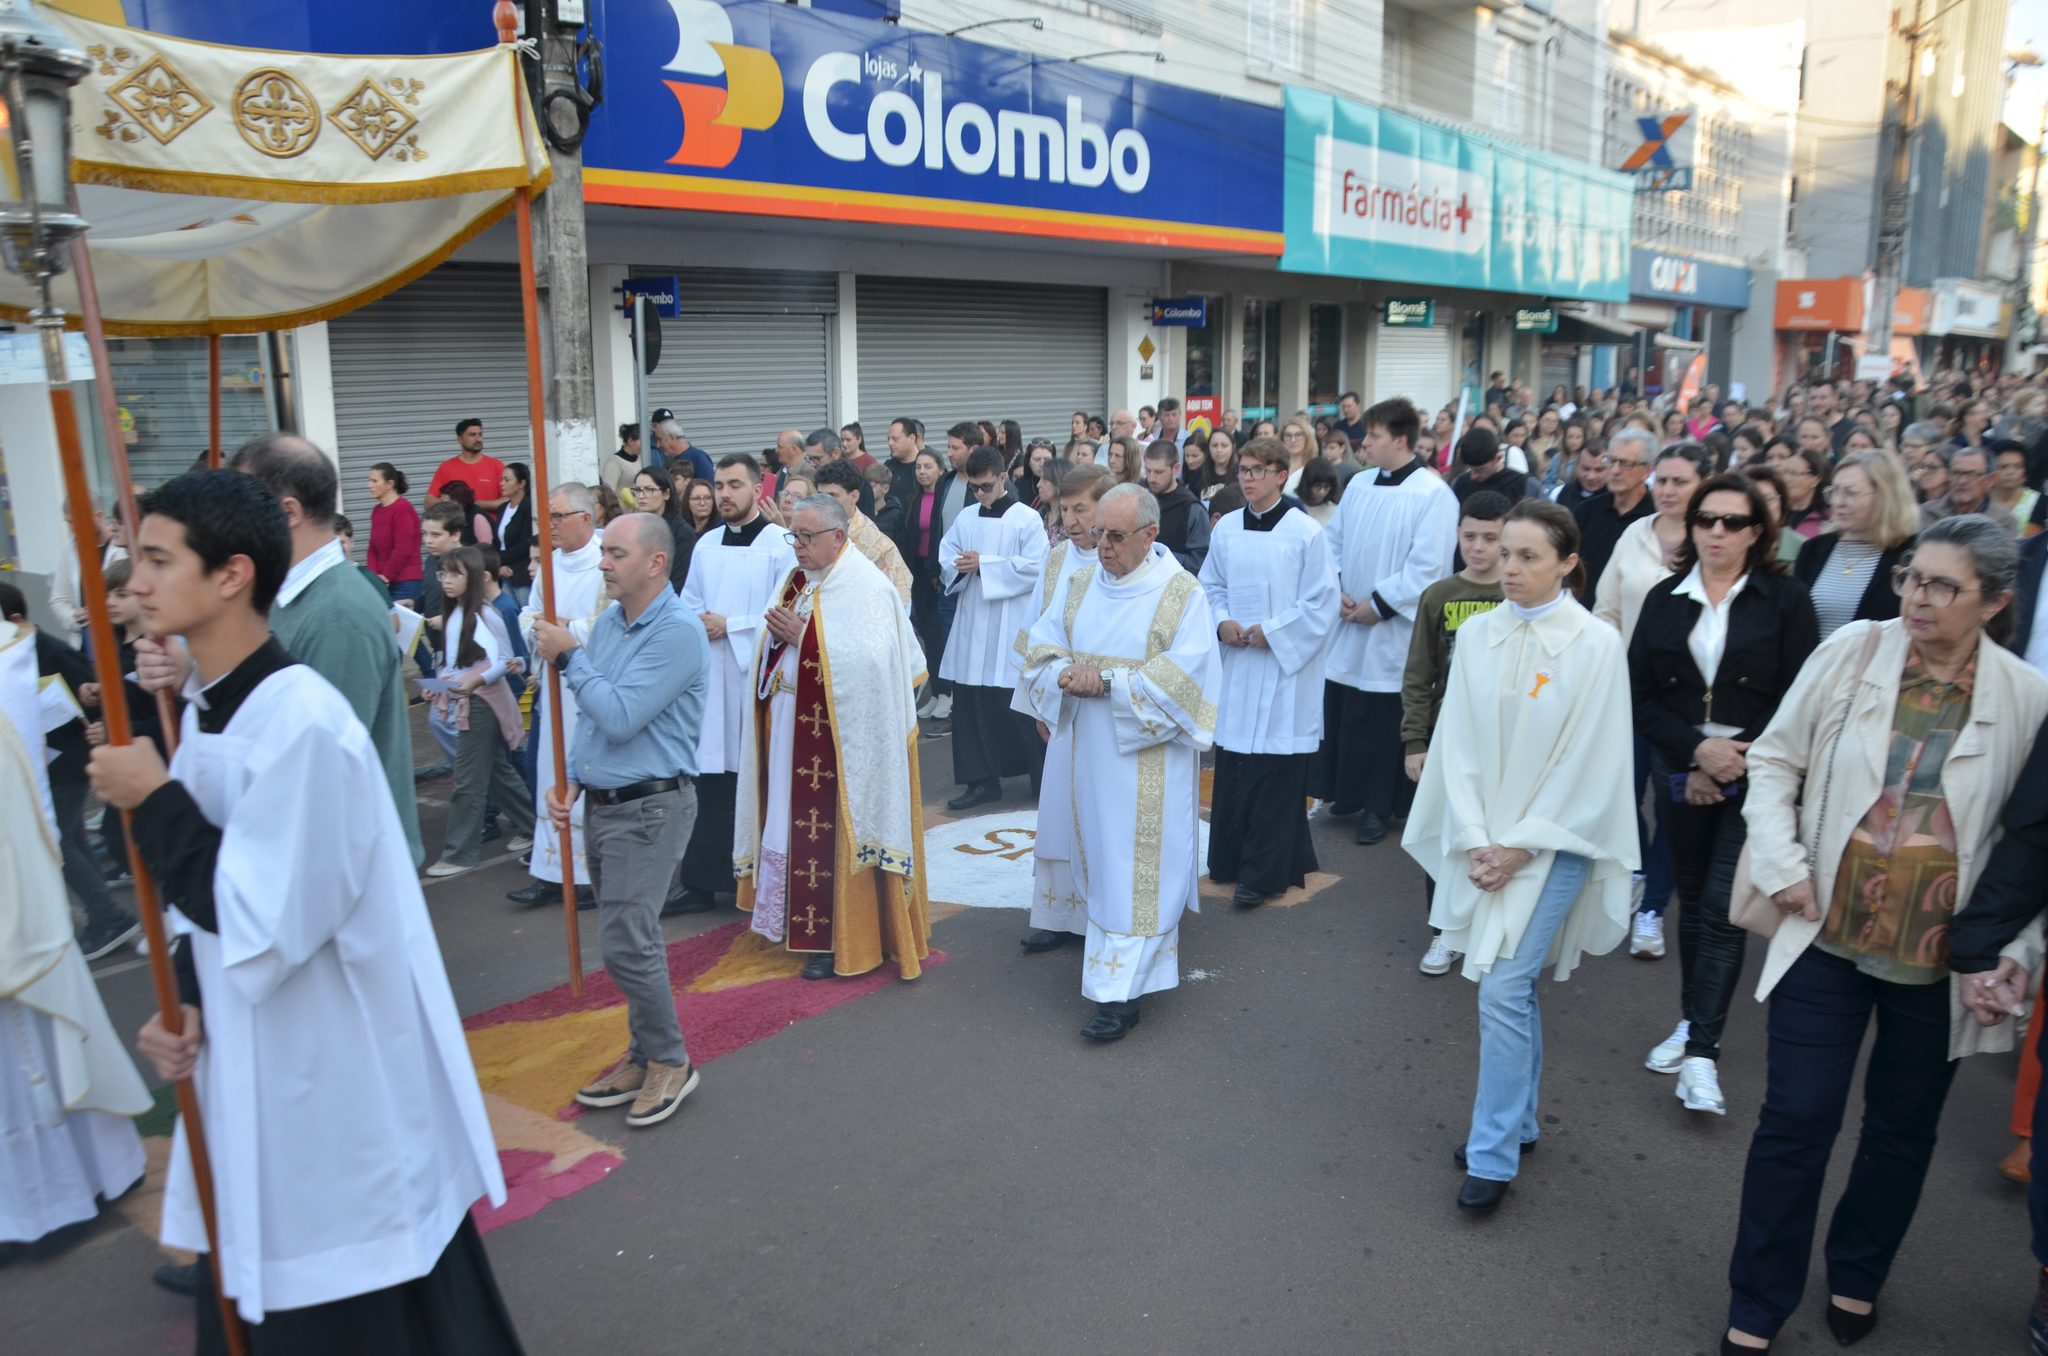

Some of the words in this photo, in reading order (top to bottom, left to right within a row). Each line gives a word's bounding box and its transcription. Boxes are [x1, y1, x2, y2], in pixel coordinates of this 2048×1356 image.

[864, 51, 898, 82] lojas
[803, 51, 1150, 193] Colombo
[1164, 307, 1202, 319] Colombo
